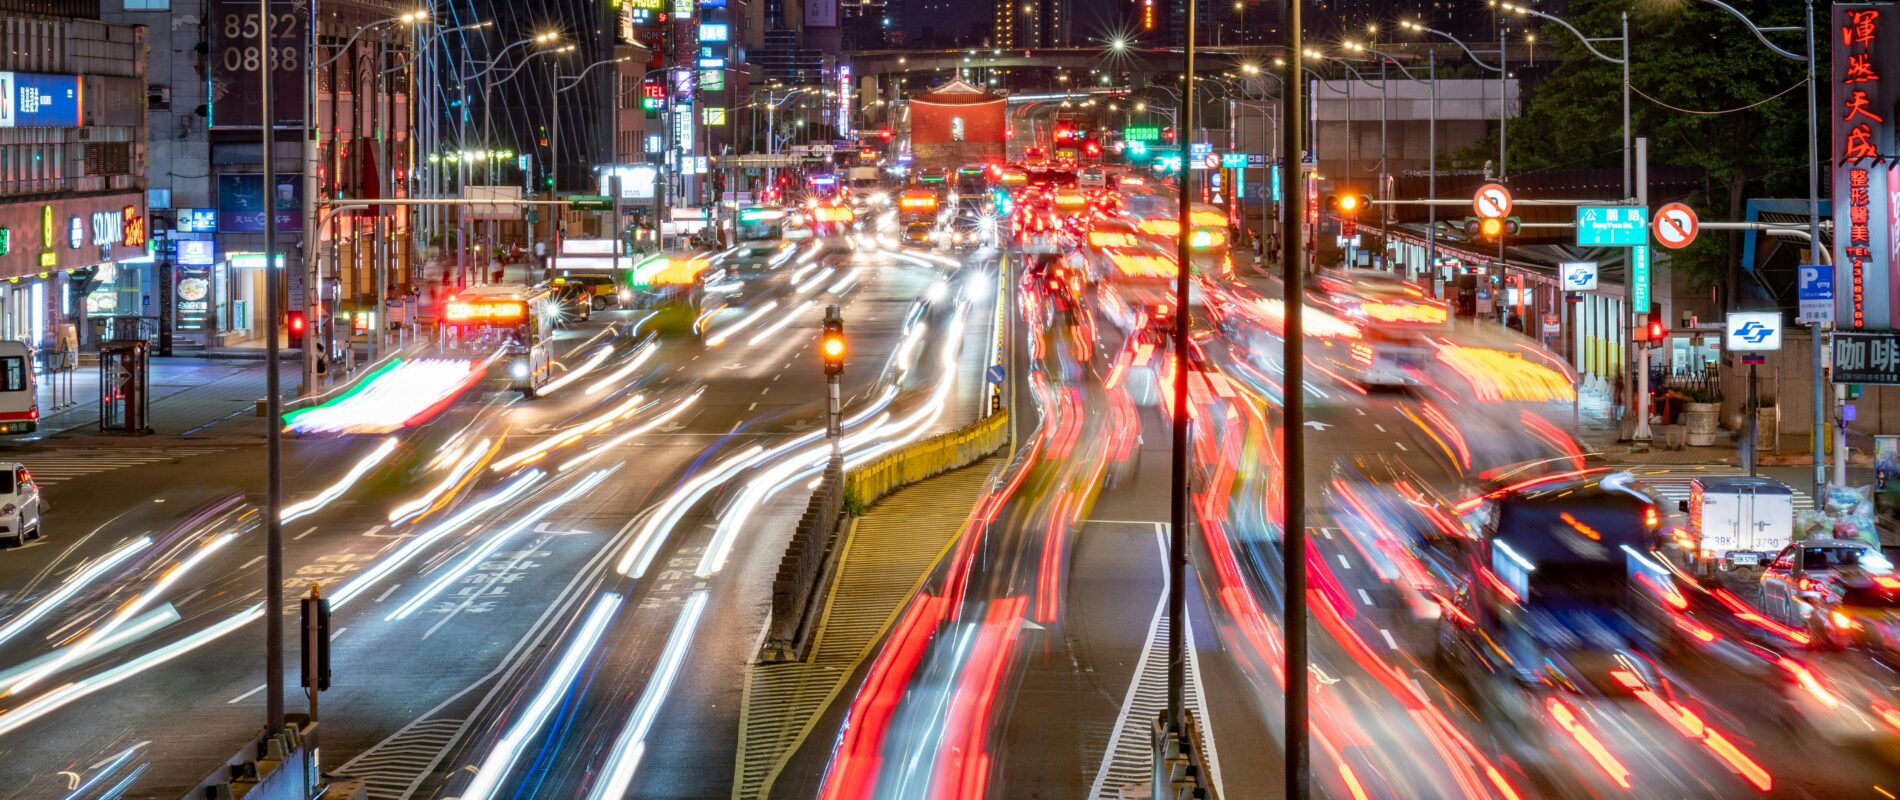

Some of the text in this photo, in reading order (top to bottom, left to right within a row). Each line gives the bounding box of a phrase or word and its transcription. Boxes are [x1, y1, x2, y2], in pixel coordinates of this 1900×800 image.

[1585, 209, 1640, 221] 公園路
[1849, 169, 1869, 242] 整形醫美
[1845, 247, 1871, 257] TEL
[1800, 267, 1818, 289] P
[1836, 337, 1900, 372] 咖啡
